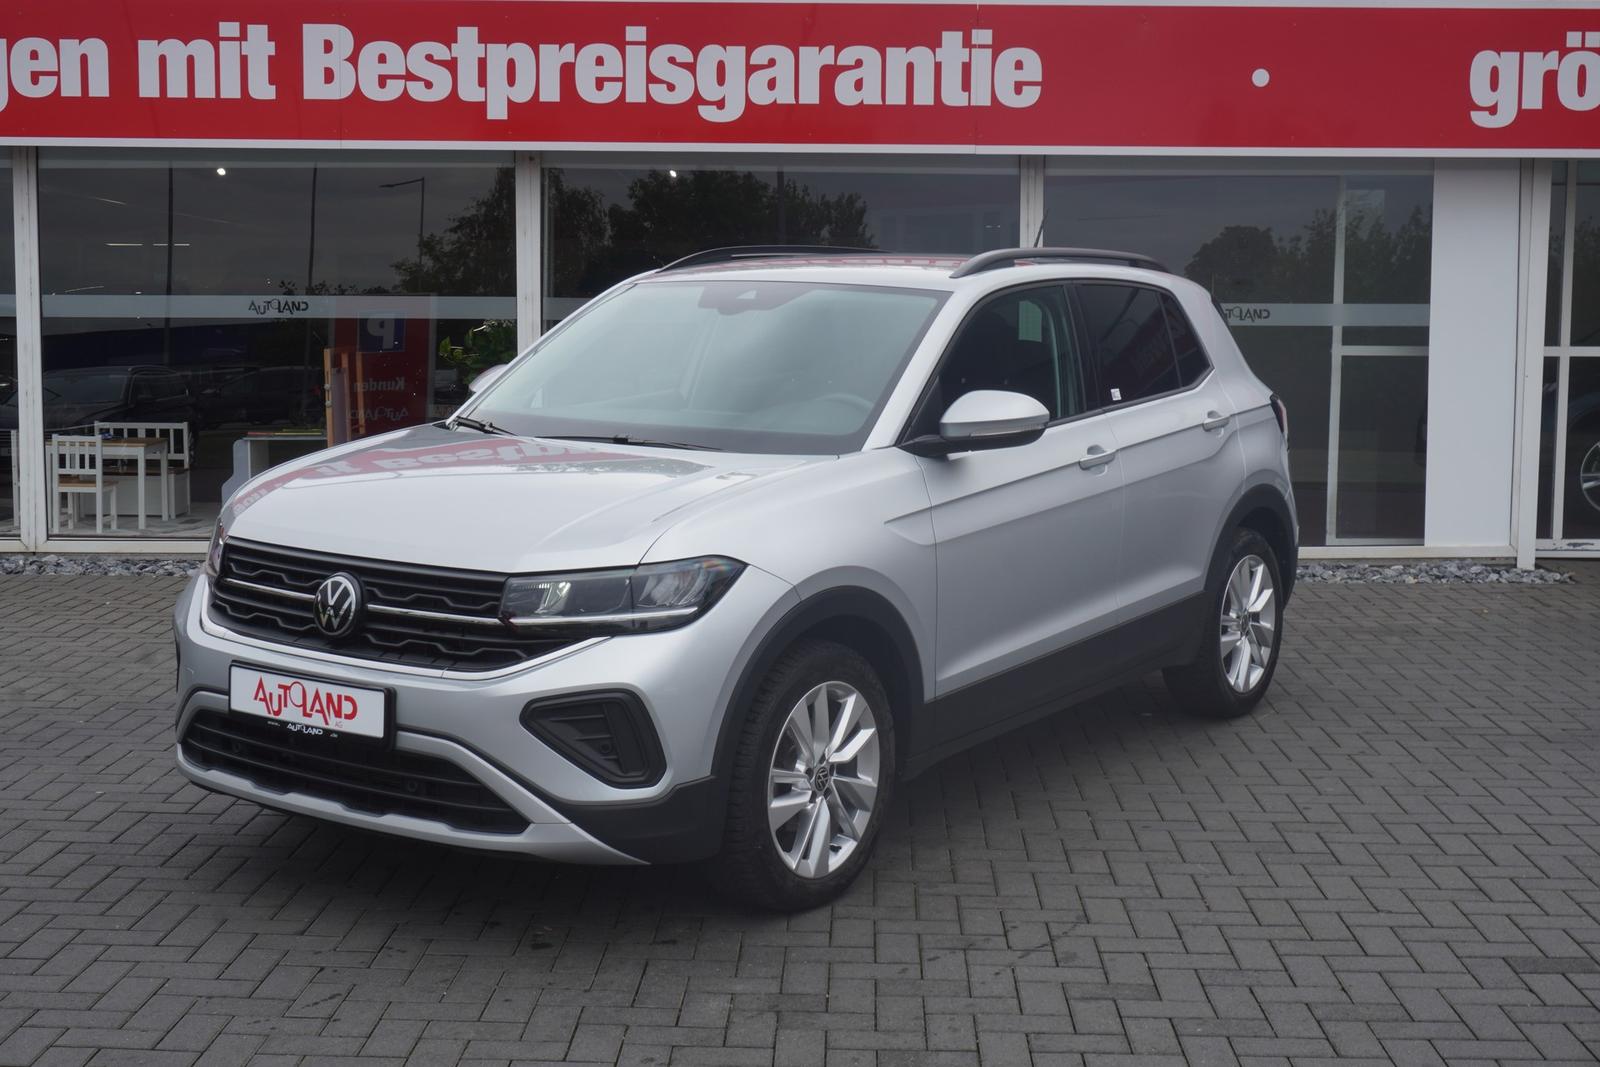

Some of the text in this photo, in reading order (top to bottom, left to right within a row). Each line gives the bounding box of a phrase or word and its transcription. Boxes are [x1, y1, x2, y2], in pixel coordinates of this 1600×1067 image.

[0, 21, 1600, 128] en mit Bestpreisgarantie grö
[1225, 306, 1271, 322] TOLAND
[254, 675, 358, 726] AUTOLAND
